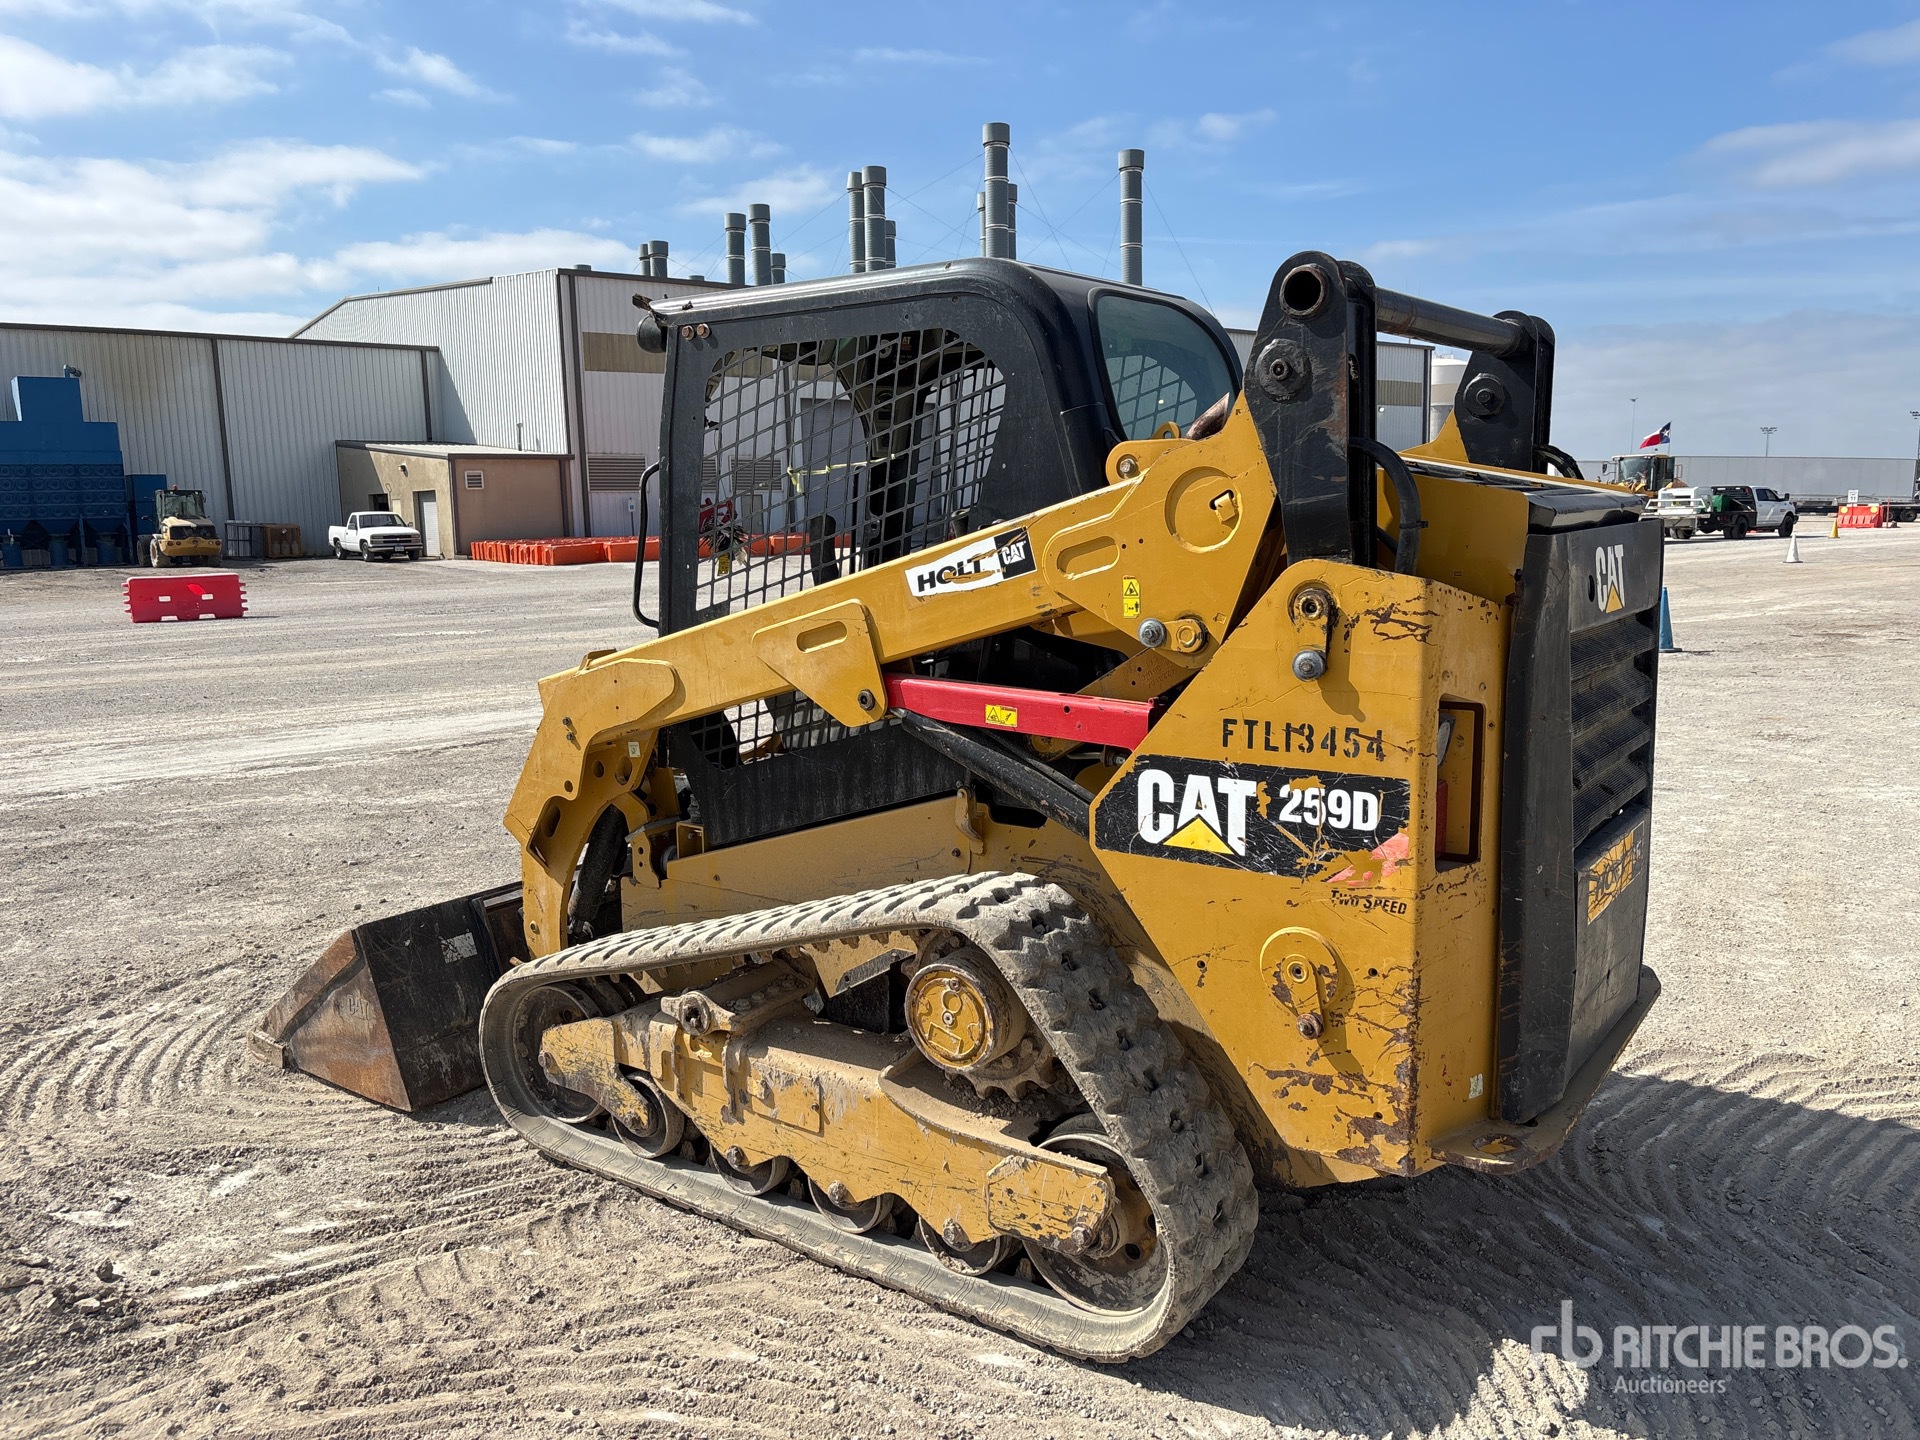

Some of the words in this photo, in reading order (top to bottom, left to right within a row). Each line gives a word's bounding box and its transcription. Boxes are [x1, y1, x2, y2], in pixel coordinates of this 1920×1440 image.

[917, 559, 982, 593] HOLT
[1001, 542, 1026, 565] CAT
[1595, 544, 1626, 613] CAT
[1137, 769, 1259, 857] CAT
[1279, 783, 1380, 832] 259D
[1362, 894, 1408, 915] SPEED
